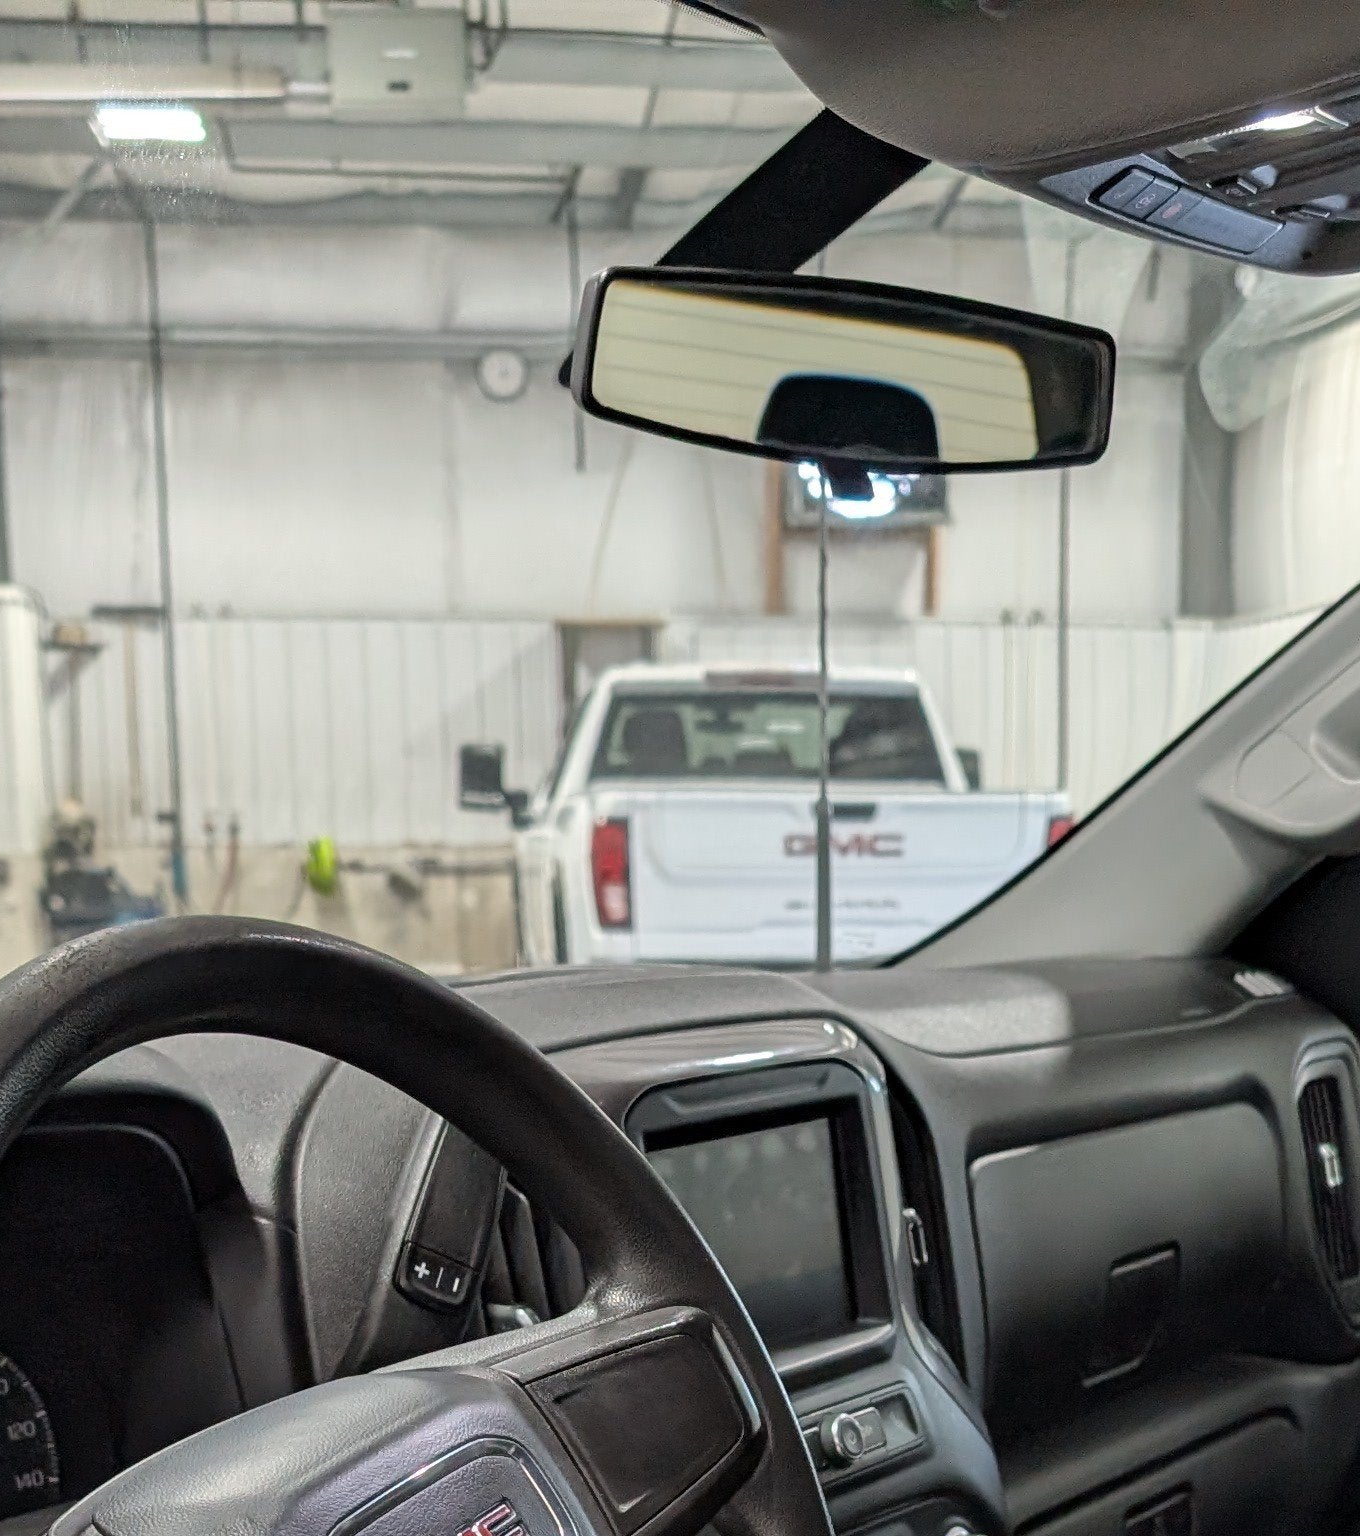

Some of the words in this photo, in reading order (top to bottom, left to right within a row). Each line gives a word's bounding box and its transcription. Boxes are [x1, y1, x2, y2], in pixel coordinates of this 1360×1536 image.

[784, 834, 904, 857] GMC
[7, 1420, 36, 1441] 120
[14, 1469, 45, 1490] 140
